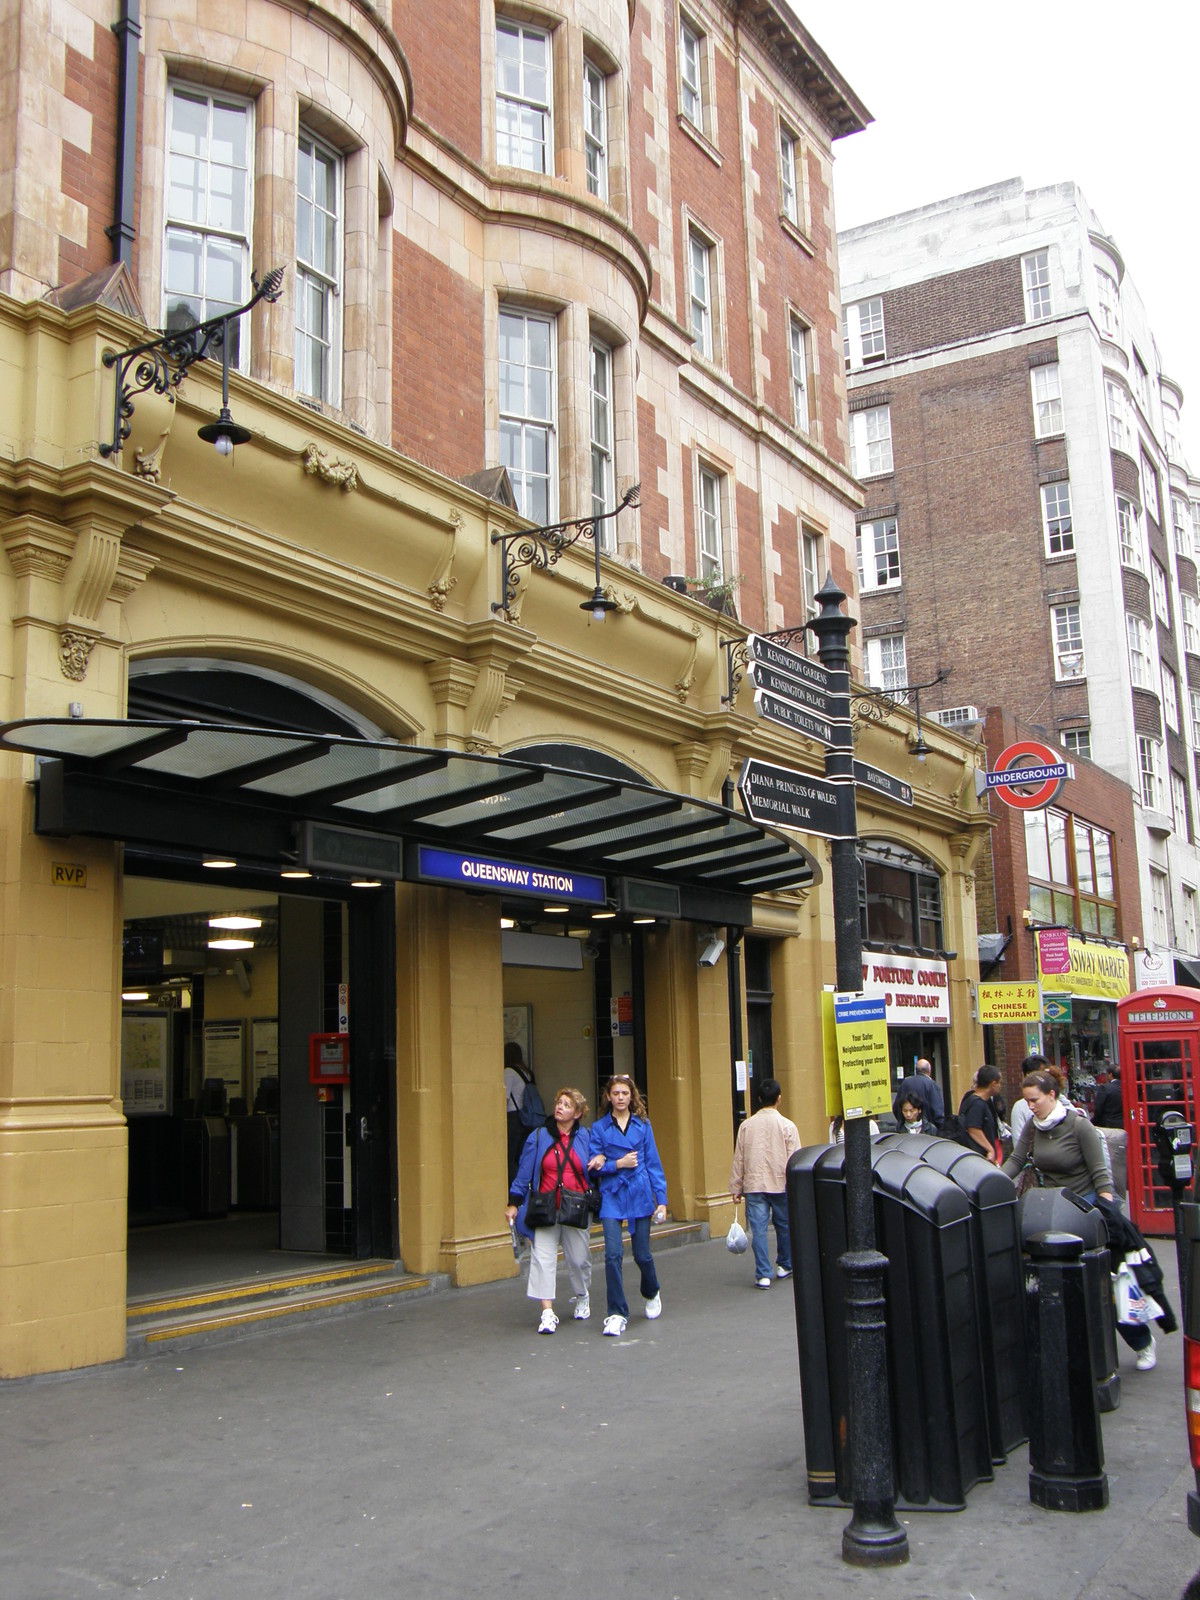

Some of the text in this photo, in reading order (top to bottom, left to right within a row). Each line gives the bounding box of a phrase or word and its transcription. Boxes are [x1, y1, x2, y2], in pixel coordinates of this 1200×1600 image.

[767, 648, 828, 685] KENSINGTON GARDENS
[770, 676, 826, 710] KENSINGTON PALACE
[773, 703, 792, 721] PUBLIC
[794, 712, 814, 731] TOILETS
[867, 770, 891, 790] BAYSWATER
[988, 766, 1065, 784] UNDERGROUND
[751, 772, 837, 805] DIANA PRINCESS OF WALES
[751, 794, 811, 819] MEMORIAL WALK
[56, 867, 84, 883] RVP
[461, 860, 573, 893] QUEENSWAY STATION
[1069, 949, 1125, 979] NSWAY MARKET
[873, 965, 914, 985] FORTUNE
[917, 969, 946, 988] COOKIE
[895, 993, 940, 1008] RESTAURANT
[849, 1008, 871, 1016] PREVENTION
[871, 1007, 884, 1015] ADVICE
[1132, 1010, 1191, 1021] TELEPHONE
[852, 1032, 873, 1042] Your Safer
[842, 1042, 884, 1055] Neighbourhood Team
[842, 1056, 886, 1068] Protecting your street
[861, 1068, 870, 1076] with
[844, 1078, 888, 1091] DNA property marking
